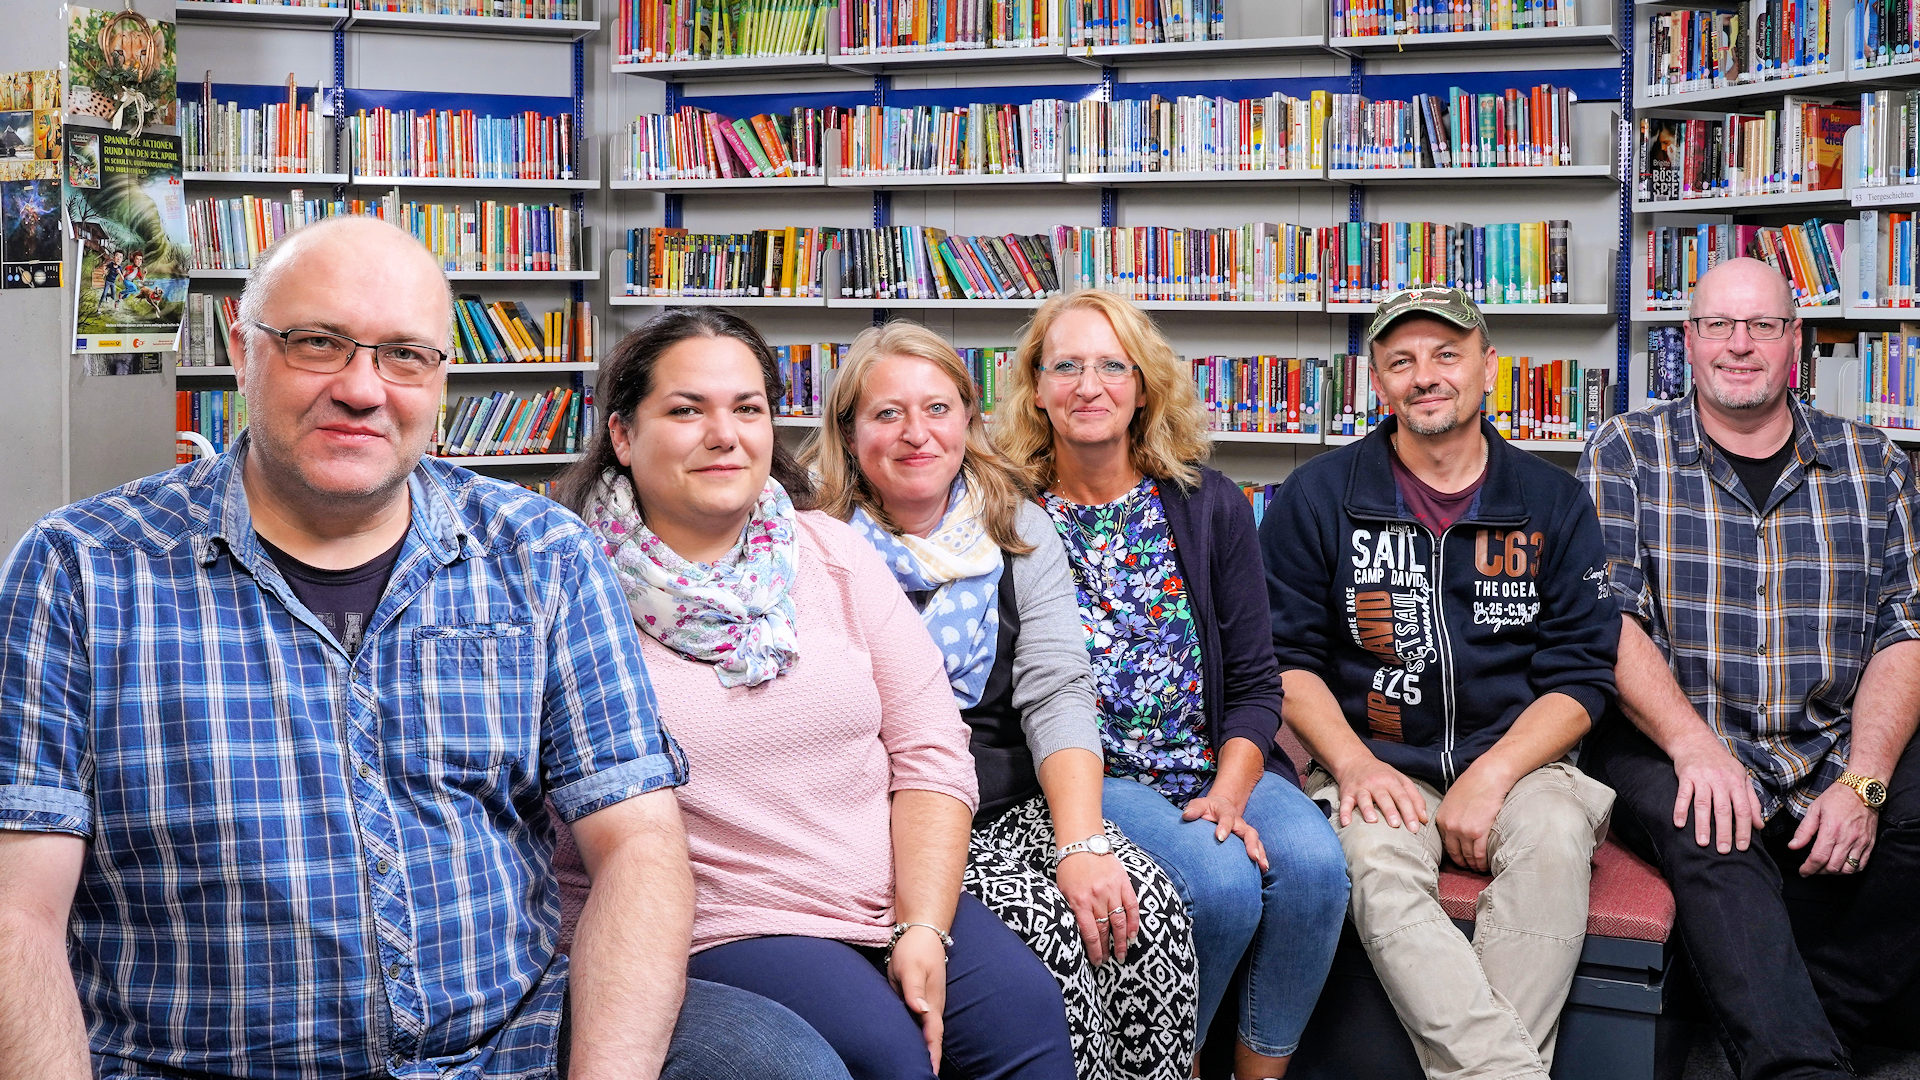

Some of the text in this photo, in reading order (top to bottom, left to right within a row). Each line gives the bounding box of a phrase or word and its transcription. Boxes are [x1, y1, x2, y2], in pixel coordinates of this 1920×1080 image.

[1830, 113, 1840, 123] Der
[104, 146, 123, 155] RUND
[125, 148, 136, 157] UM
[136, 149, 149, 158] DEN
[161, 152, 178, 161] APRIL
[142, 139, 174, 150] AKTIONEN
[1800, 361, 1809, 402] Seelen
[1588, 385, 1598, 412] EREBOS
[1351, 529, 1426, 572] SAIL
[1354, 568, 1424, 588] CAMP DAVID
[1474, 580, 1539, 598] THE OCEA
[1345, 586, 1364, 648] SHORE RACE
[1392, 588, 1420, 637] SAIL
[1384, 669, 1422, 705] 25
